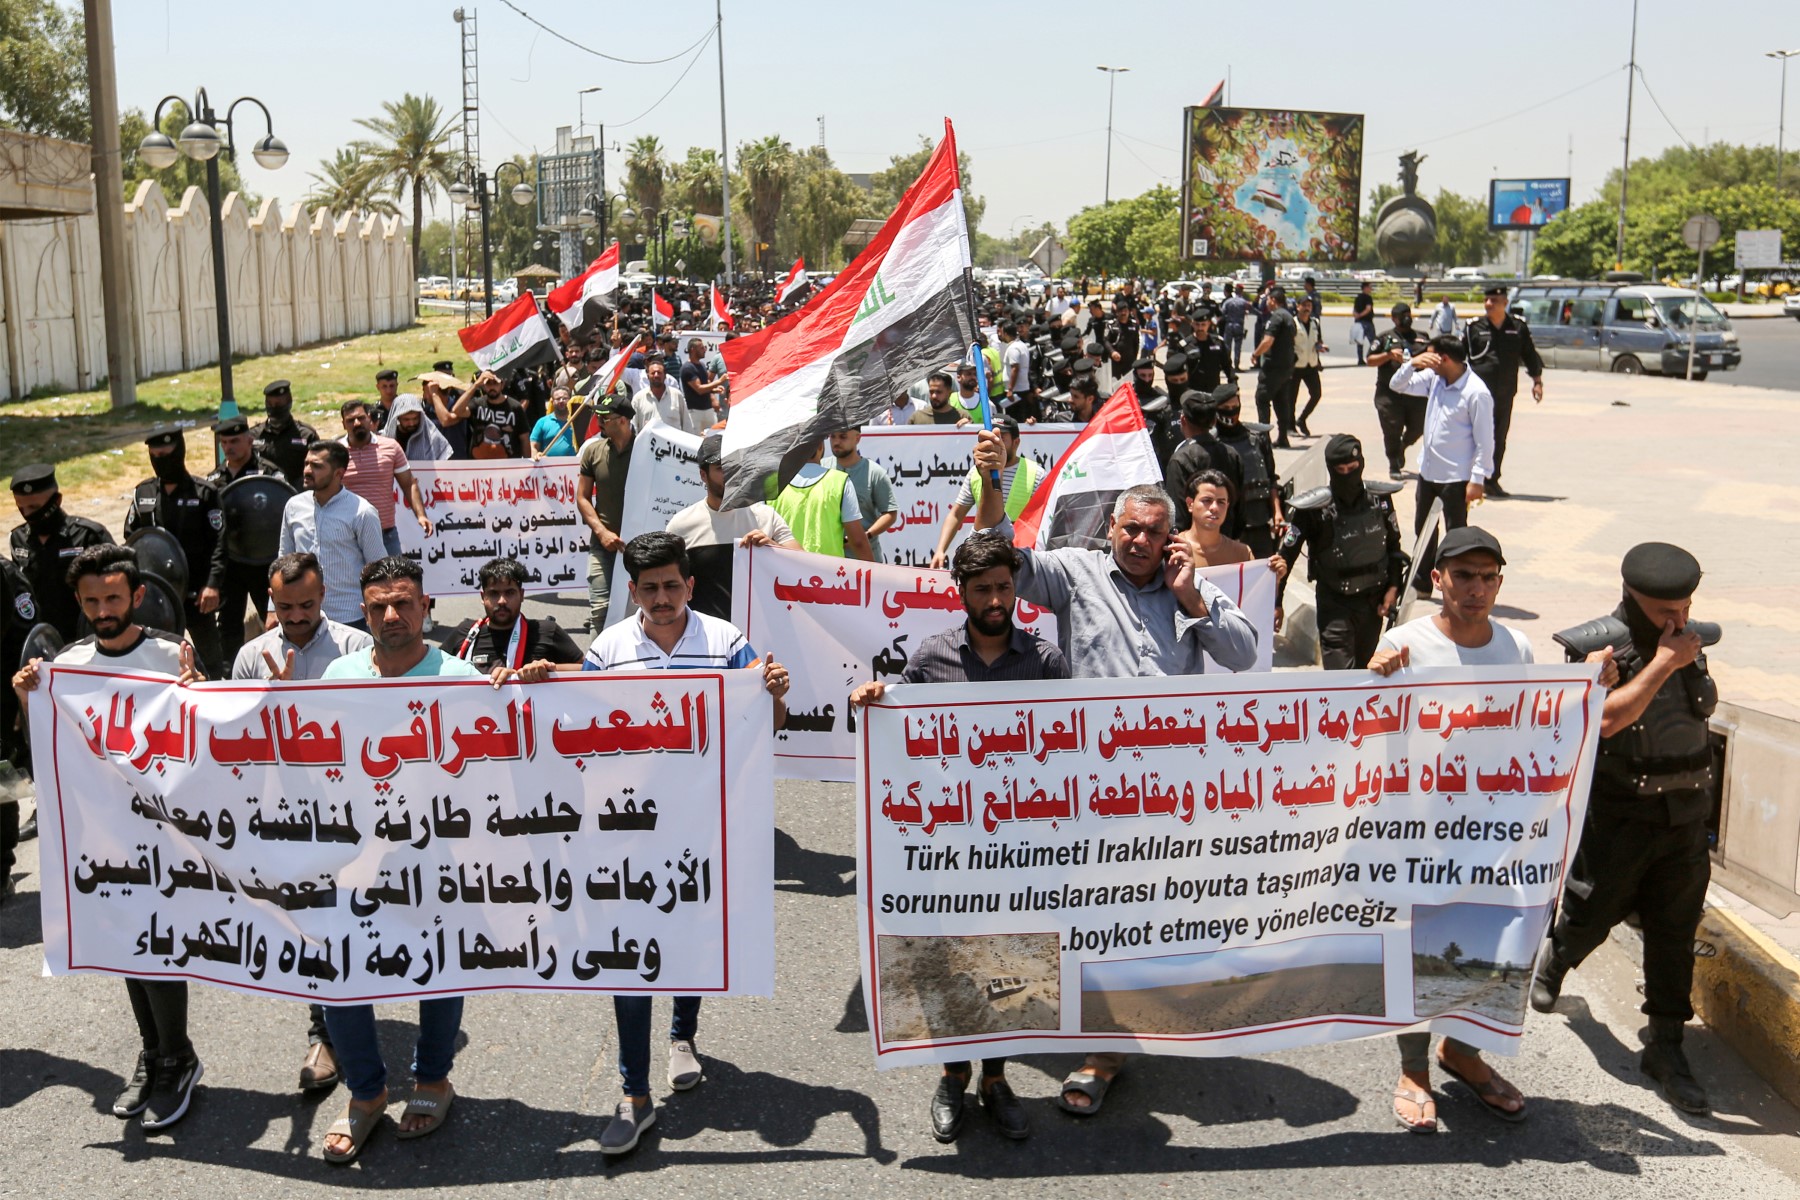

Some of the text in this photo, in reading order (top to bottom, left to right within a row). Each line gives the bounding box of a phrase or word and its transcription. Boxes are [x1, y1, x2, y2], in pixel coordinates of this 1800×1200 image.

[476, 406, 516, 427] NASA
[650, 437, 698, 465] سوداني؟
[457, 478, 493, 508] لازالت
[498, 476, 540, 507] الكهرباء
[435, 510, 576, 537] تستحون من شعبكم
[427, 541, 446, 564] لن
[450, 539, 502, 562] الشعب
[507, 534, 529, 560] بأن
[534, 537, 563, 559] المرة
[547, 563, 576, 586] على
[773, 565, 871, 612] الشعب
[882, 575, 968, 629] مثلي
[79, 690, 709, 795] الشعب العراقي يطالب البرلمان
[903, 688, 1565, 770] إذا استمرت الحكومة التركية بتعطيش العراقيين فإننا
[598, 787, 658, 831] عقد
[881, 751, 1574, 836] سنذهب تجاه تدويل قضية المياه ومقاطعة البضائع التركية
[248, 797, 362, 845] لمناقشة
[374, 794, 471, 850] طارئة
[486, 791, 582, 843] جلسة
[903, 815, 1549, 871] Türk hükümeti Iraklıları susatmaya devam ederse su
[74, 844, 711, 928] الأزمات والمعاناة التي تعصف بالعراقيين
[880, 890, 1000, 914] sorununu
[1008, 882, 1157, 912] uluslararası
[1164, 871, 1248, 904] boyuta
[1256, 861, 1360, 898] taşımaya
[1369, 862, 1397, 883] ve
[1405, 857, 1462, 885] Türk
[1160, 917, 1248, 943] etmeye
[1255, 900, 1397, 940] yöneleceğiz
[133, 911, 661, 990] وعلى رأسها أزمة المياه والكهرباء
